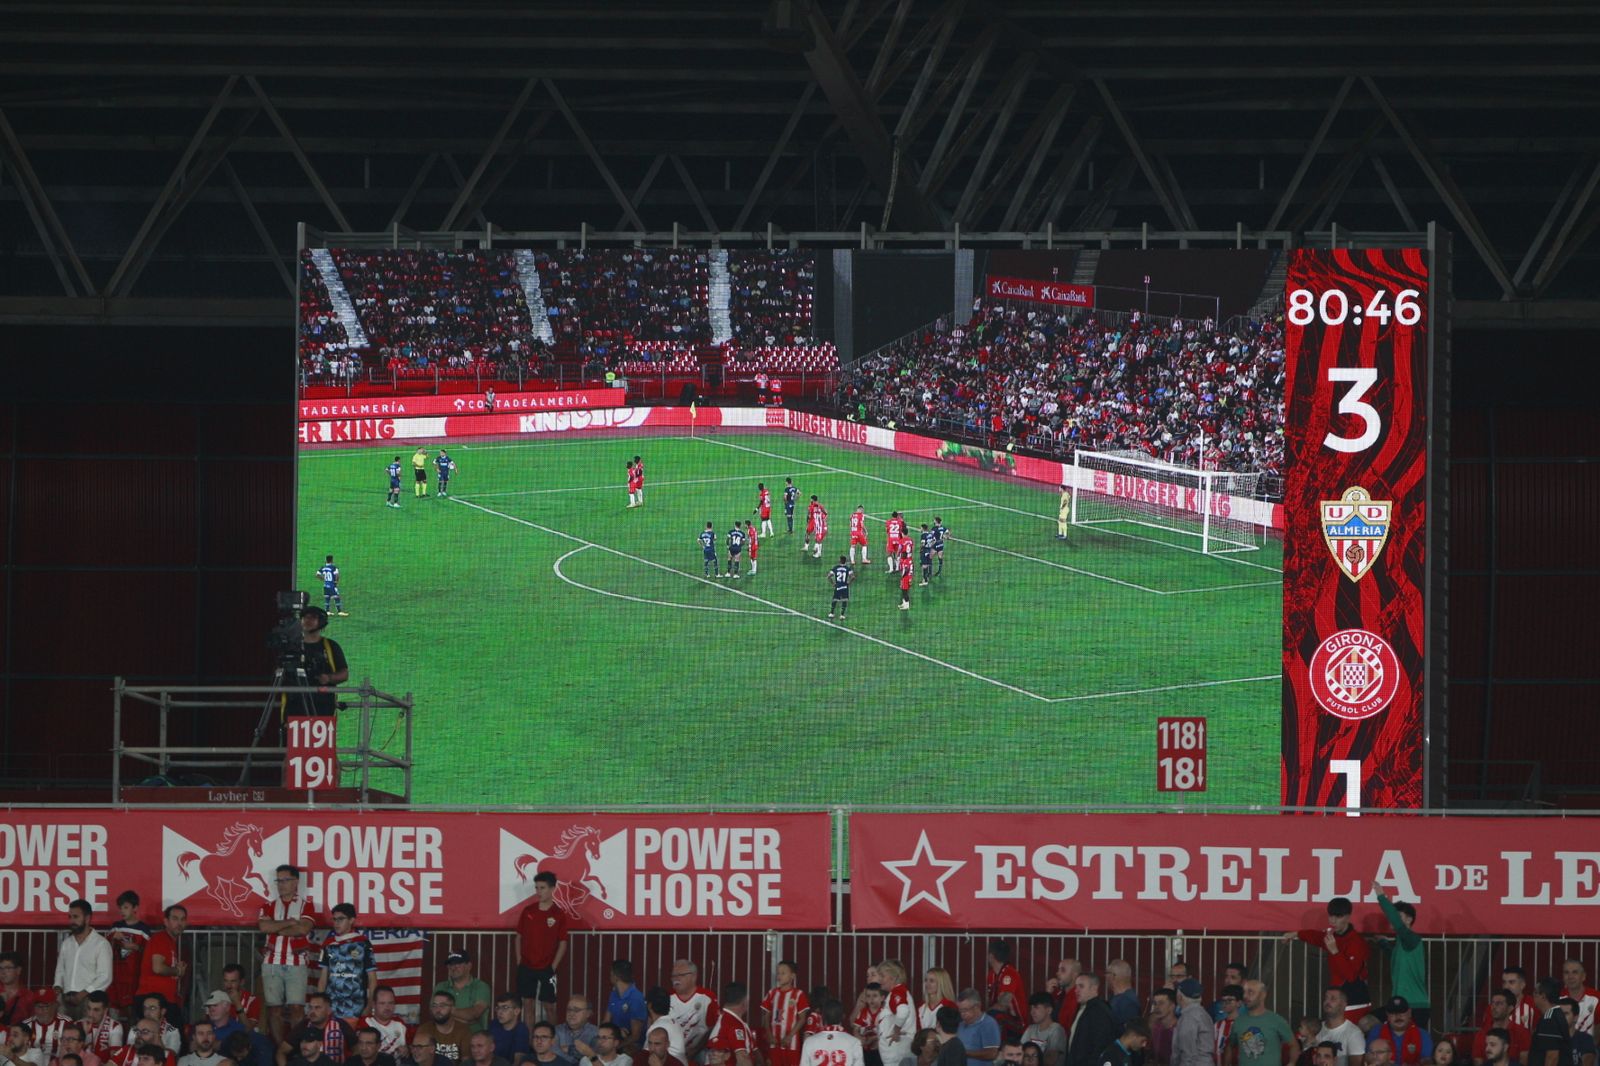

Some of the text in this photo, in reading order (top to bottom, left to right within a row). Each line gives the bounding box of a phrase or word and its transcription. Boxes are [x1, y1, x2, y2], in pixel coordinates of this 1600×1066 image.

[1288, 289, 1421, 325] 80:46
[468, 393, 588, 409] COTADEALMERÍA
[1323, 368, 1381, 453] 3
[330, 419, 395, 442] KING
[788, 410, 868, 444] BURGER KING
[1113, 473, 1178, 508] BURGER
[1329, 507, 1382, 518] U D
[1329, 526, 1382, 536] ALMERIA
[1326, 633, 1383, 655] GIRONA
[1326, 696, 1383, 713] FUTBOL CLUB
[289, 720, 327, 748] 119
[1159, 721, 1196, 750] 118
[289, 756, 325, 788] 19
[1160, 757, 1195, 789] 18
[1330, 760, 1360, 816] 1
[208, 790, 248, 803] Layher
[0, 824, 108, 868] OWER
[297, 825, 443, 869] POWER
[635, 827, 781, 871] POWER
[0, 869, 108, 912] ORSE
[974, 844, 1600, 905] ESTRELLA DE LE
[298, 871, 443, 914] HORSE
[635, 873, 782, 916] HORSE
